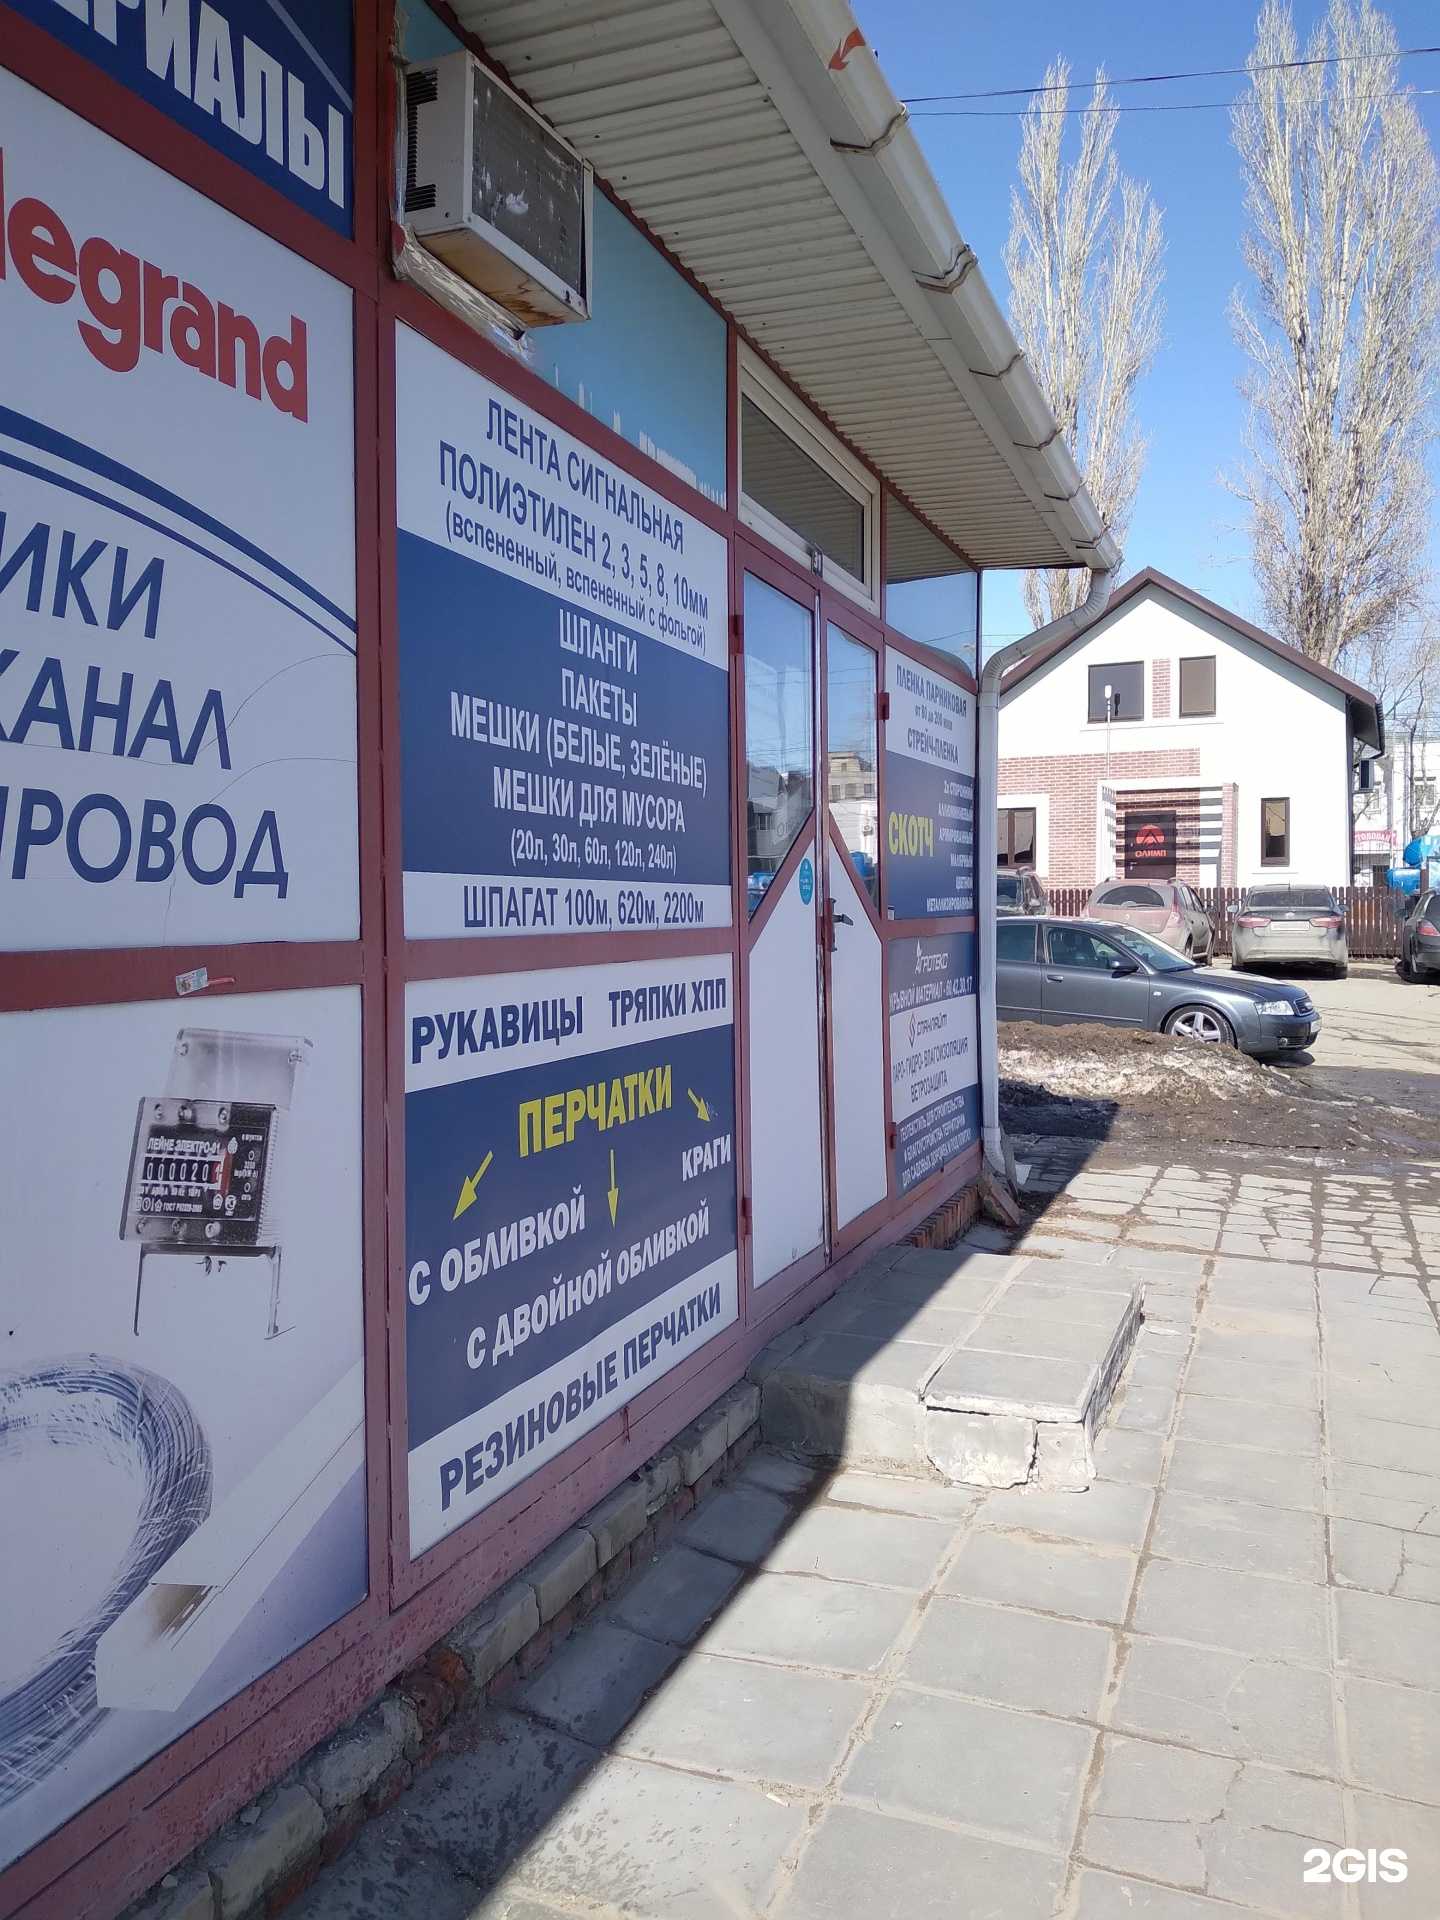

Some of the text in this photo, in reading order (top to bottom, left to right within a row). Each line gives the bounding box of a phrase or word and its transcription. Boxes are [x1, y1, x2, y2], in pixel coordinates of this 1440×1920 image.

[53, 0, 345, 209] ИАЛЫ
[487, 398, 684, 554] ЛЕНТА СИГНАЛЬНАЯ
[440, 440, 708, 620] ПОЛИЭТИЛЕН 2, 3, 5, 8, 10мм
[446, 500, 707, 656] (вспененный, вспененный с фольгой)
[559, 608, 638, 675] ШЛАНГИ
[561, 667, 638, 727] ПАКЕТЫ
[450, 691, 707, 798] МЕШКИ (БЕЛЫЕ, ЗЕЛЁНЫЕ)
[493, 766, 686, 832] МЕШКИ ДЛЯ МУСОРА
[888, 811, 934, 857] СКОТЧ
[511, 827, 677, 876] (20л, 30л, 60л, 120л, 240л)
[1135, 849, 1167, 858] ОЛИМП
[463, 885, 704, 931] ШПАГАТ 100м, 620м, 2200м
[412, 977, 726, 1065] РУКАВИЦЫ ТРЯПКИ ХПП
[518, 1064, 672, 1158] ПЕРЧАТКИ
[682, 1133, 731, 1182] КРАГИ
[408, 1184, 585, 1306] С ОБЛИВКОЙ
[466, 1197, 710, 1369] С ДВОЙНОЙ ОБЛИВКОЙ
[440, 1282, 721, 1512] РЕЗИНОВЫЕ ПЕРЧАТКИ
